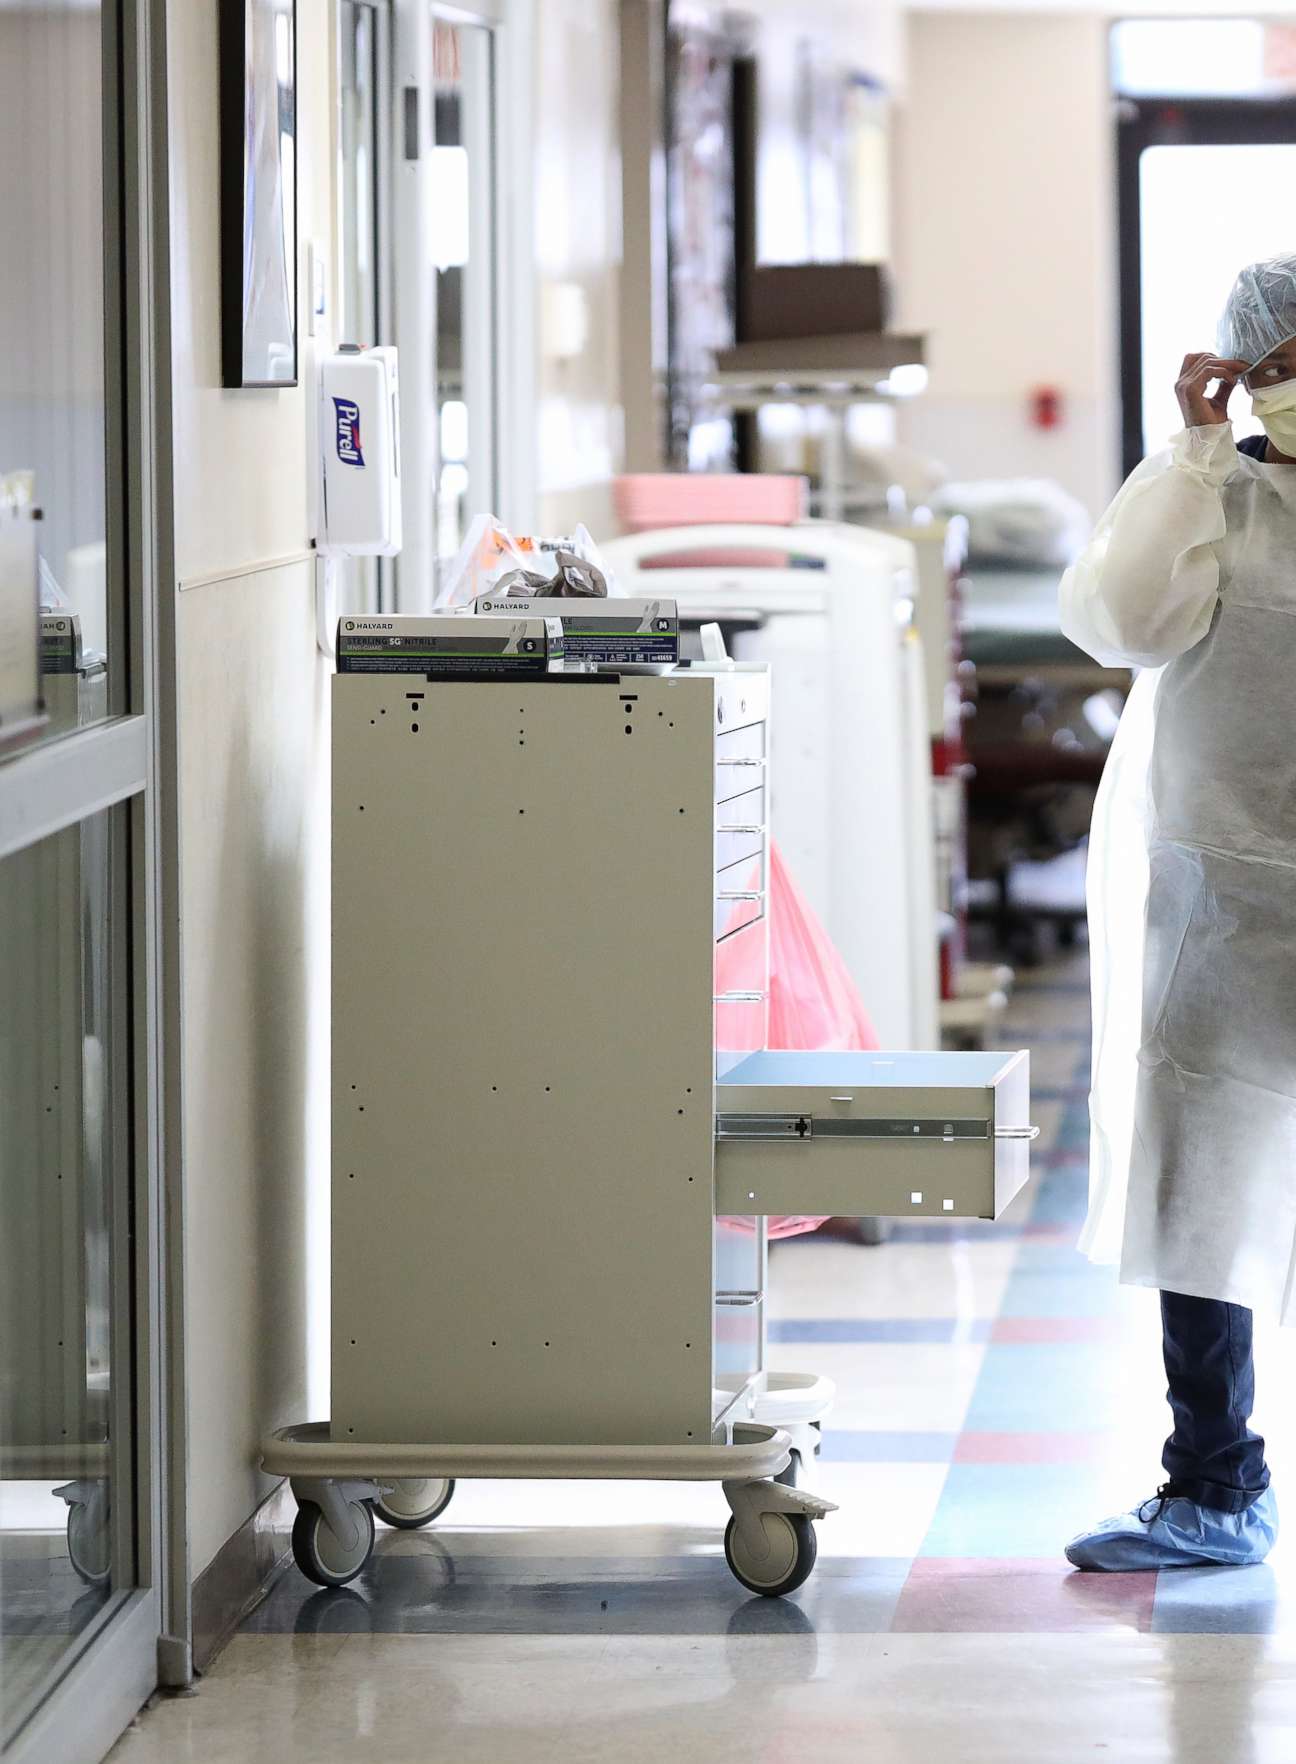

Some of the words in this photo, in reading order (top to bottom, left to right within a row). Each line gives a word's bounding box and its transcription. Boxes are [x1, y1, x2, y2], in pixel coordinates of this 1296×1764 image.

[338, 405, 358, 461] Purell
[659, 621, 669, 629] M
[405, 638, 437, 646] NITRILE
[527, 642, 534, 650] S
